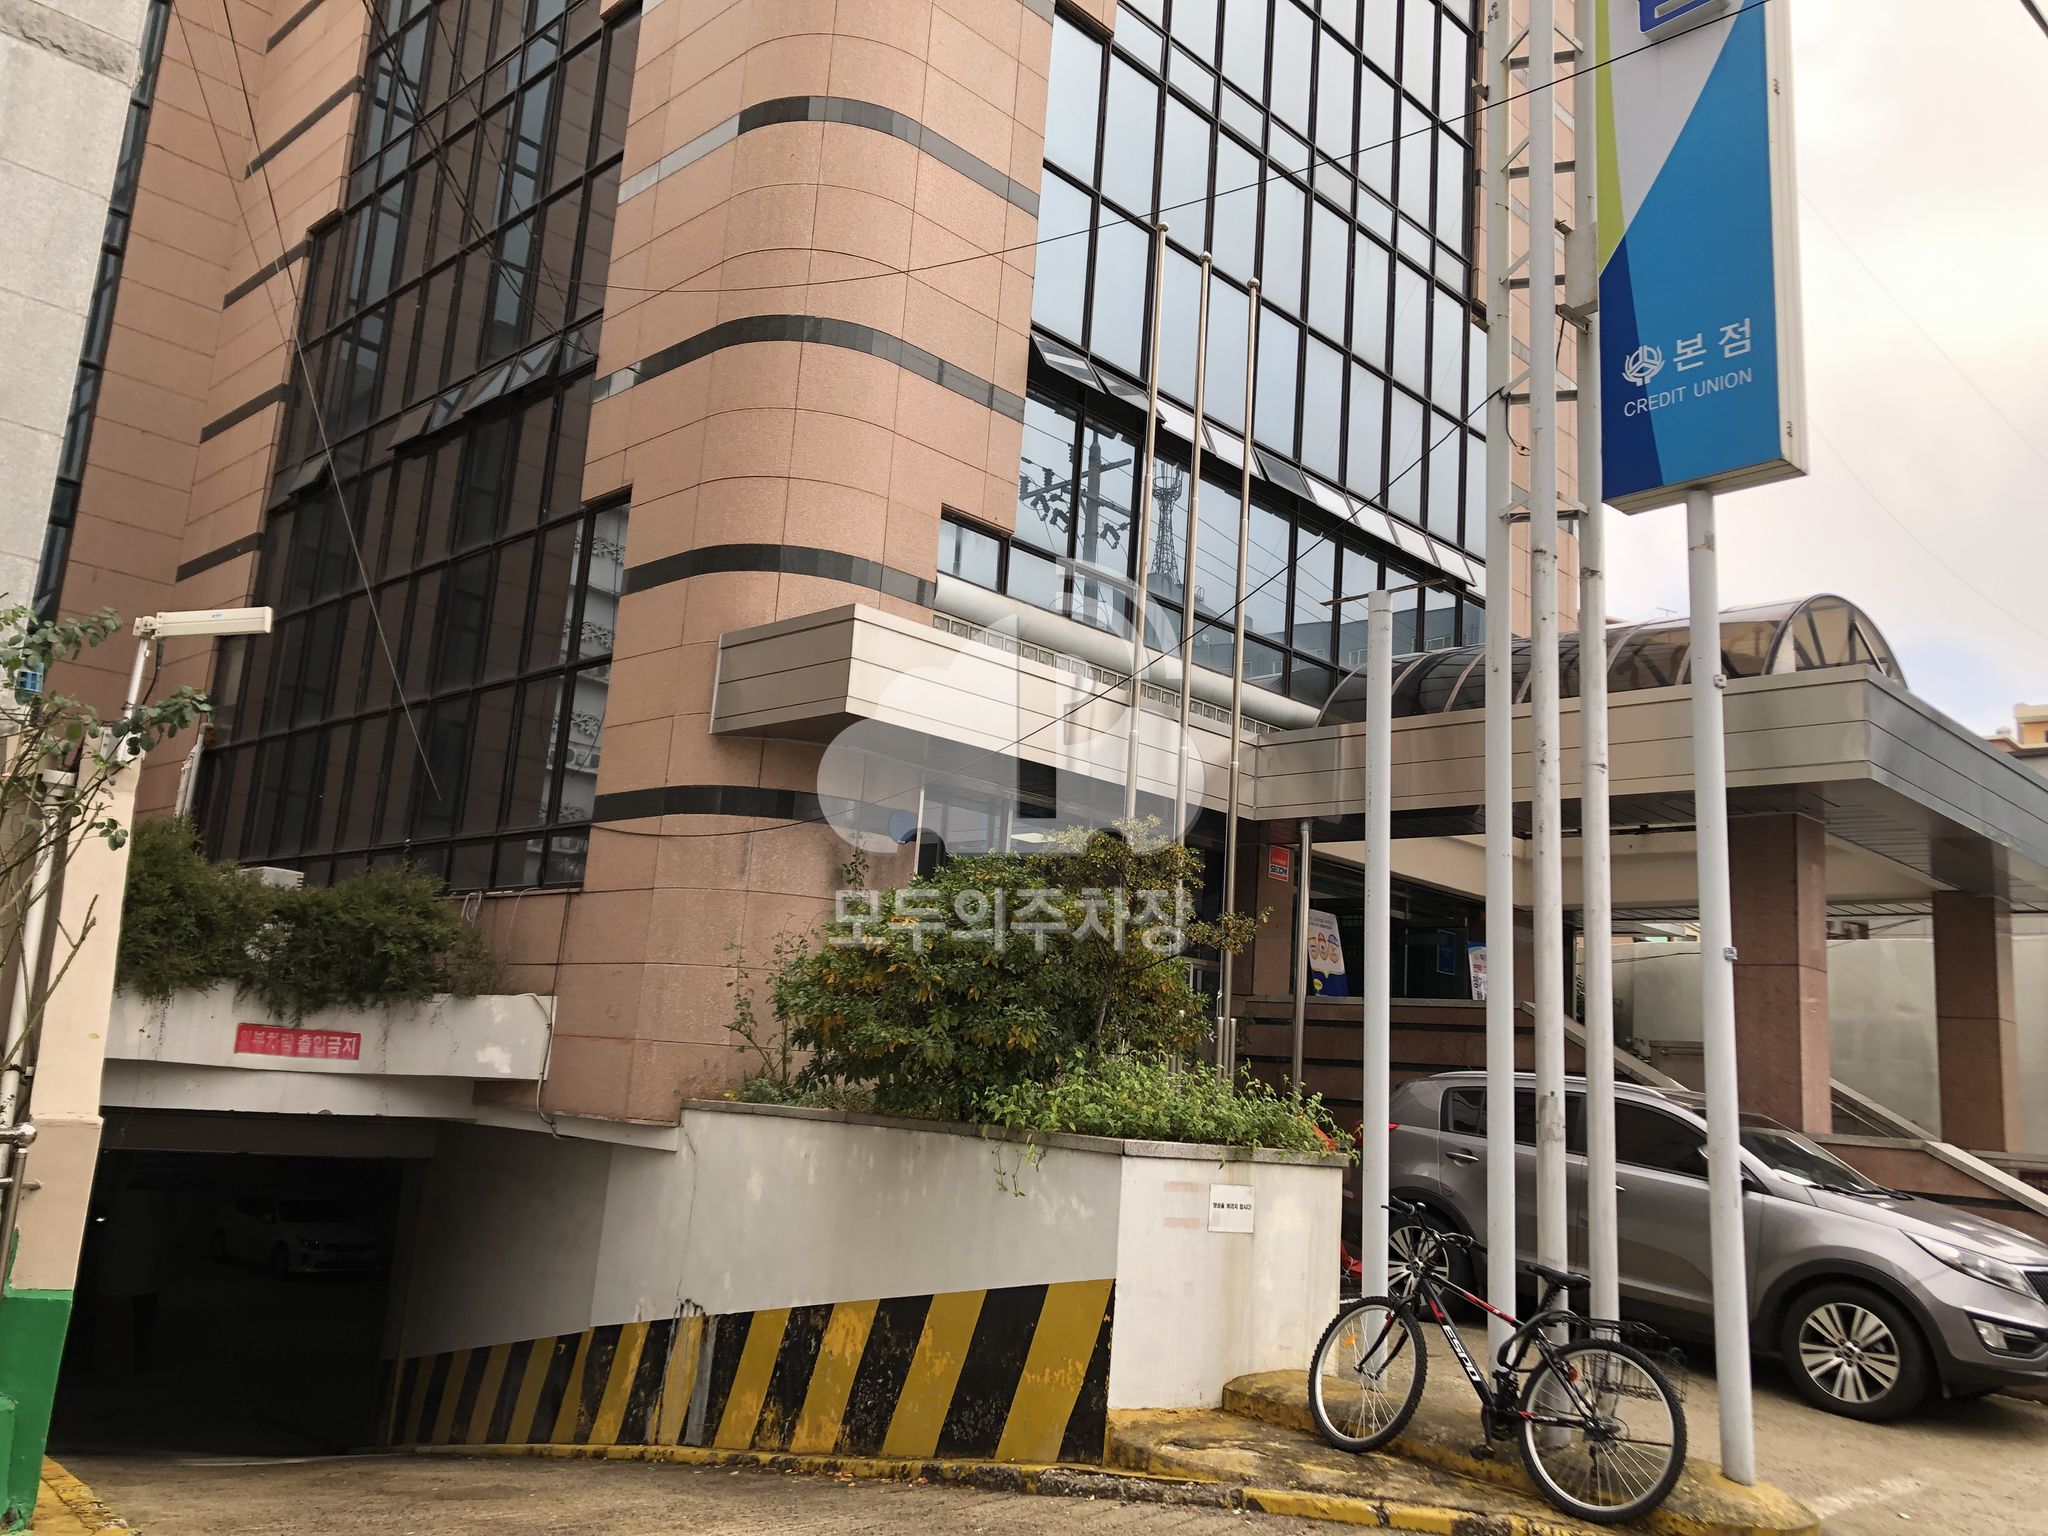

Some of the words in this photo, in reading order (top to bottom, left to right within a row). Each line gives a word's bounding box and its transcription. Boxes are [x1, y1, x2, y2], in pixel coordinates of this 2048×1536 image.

[1624, 386, 1686, 417] CREDIT
[1694, 367, 1752, 397] UNION
[298, 1034, 357, 1056] 출입금지
